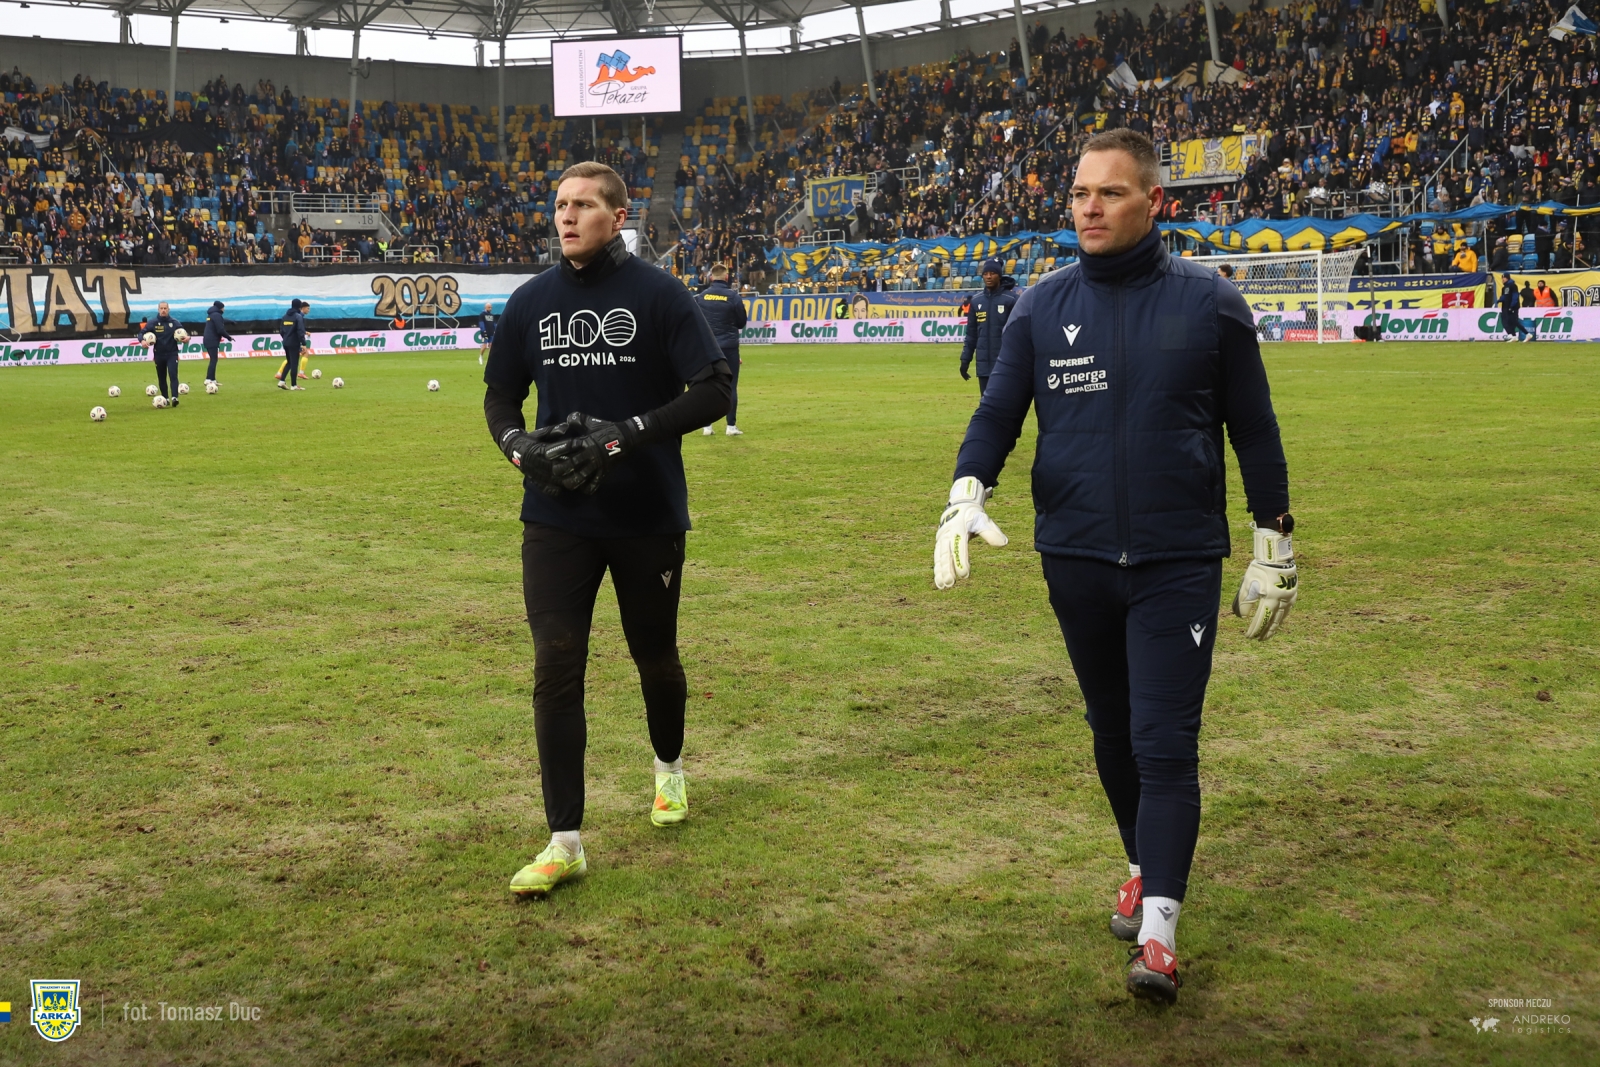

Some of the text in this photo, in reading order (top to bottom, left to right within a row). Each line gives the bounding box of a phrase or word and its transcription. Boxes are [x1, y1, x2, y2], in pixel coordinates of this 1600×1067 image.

[588, 80, 650, 106] Pekazet
[0, 268, 138, 334] IAT
[371, 275, 462, 317] 2026
[539, 307, 637, 351] 100
[791, 322, 838, 339] Clovin
[853, 321, 905, 338] Clovin
[330, 334, 386, 349] Clovin
[404, 332, 457, 347] Clovin
[82, 342, 149, 359] Clovin
[558, 352, 617, 367] GDYNIA
[1049, 355, 1095, 368] SUPERBET
[1062, 369, 1107, 385] Energa
[1065, 382, 1108, 394] GRUPA ORLEN
